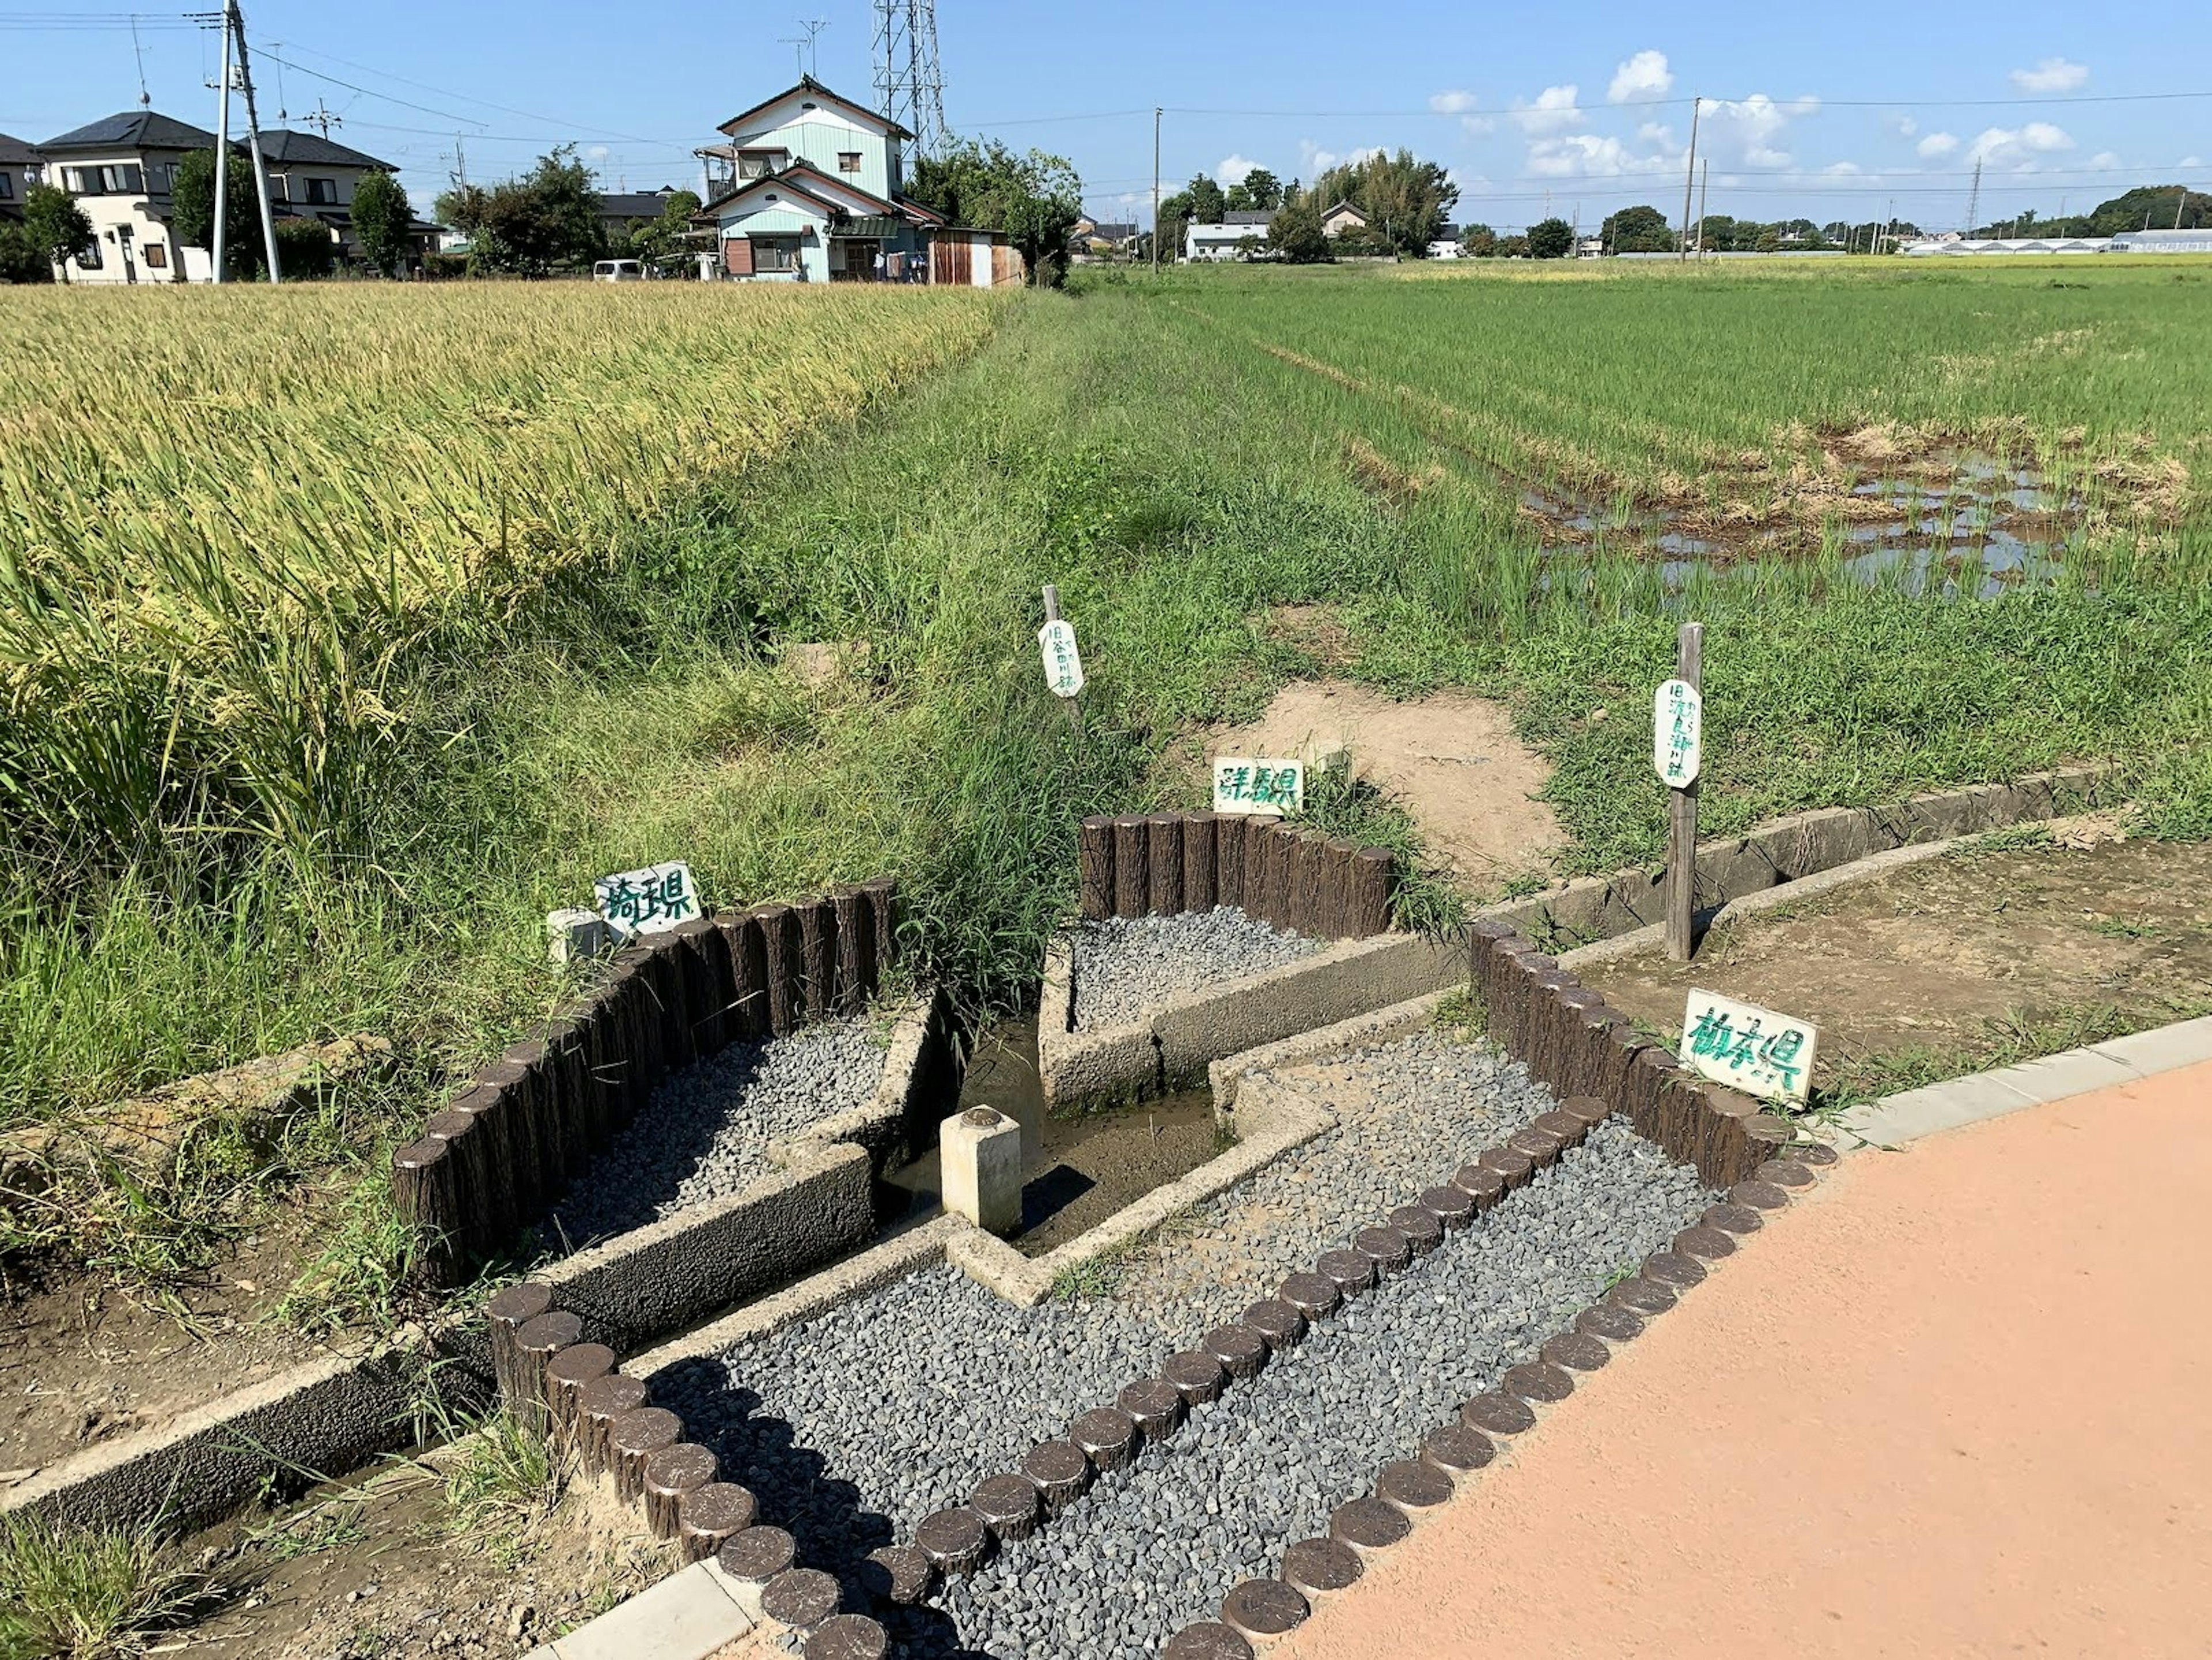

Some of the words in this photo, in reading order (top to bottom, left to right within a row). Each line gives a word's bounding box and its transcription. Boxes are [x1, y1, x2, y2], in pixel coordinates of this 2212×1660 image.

[1668, 685, 1694, 778] 旧渡良瀬川跡
[1217, 766, 1298, 804] 群馬県
[606, 869, 694, 928] 埼玉県
[1688, 1007, 1804, 1090] 栃木県
